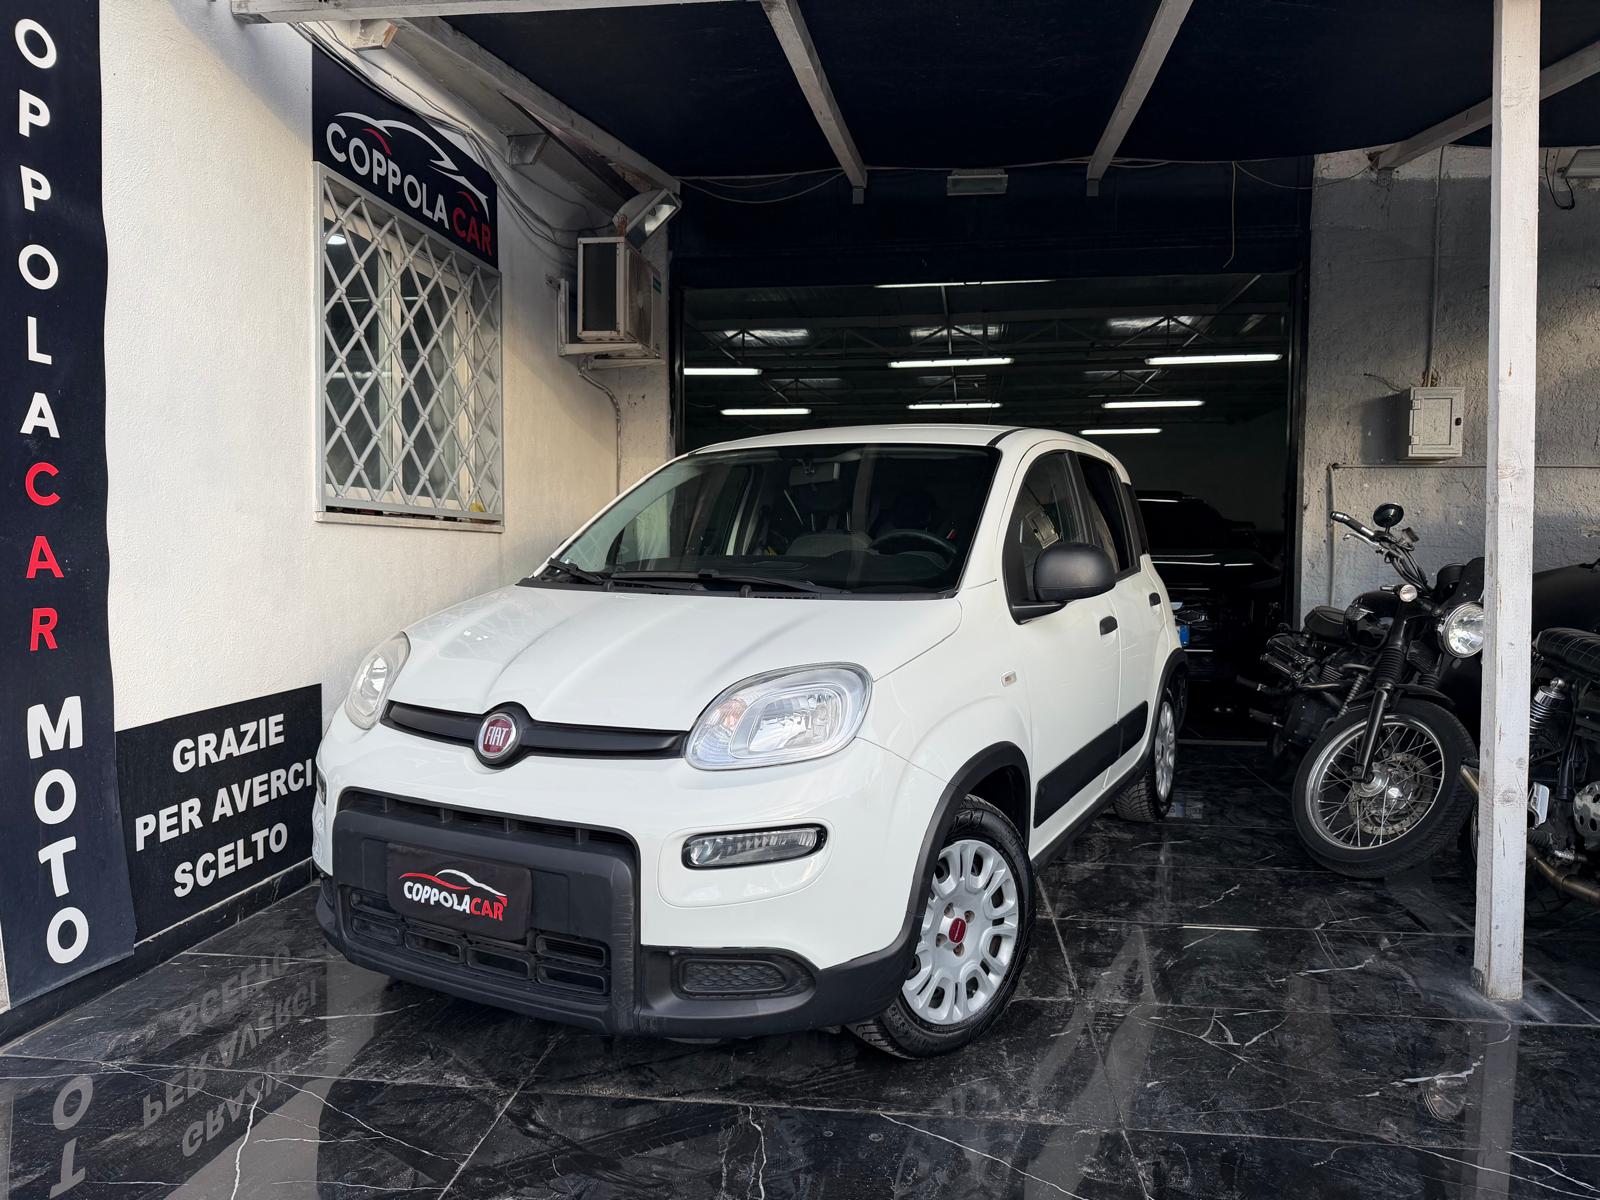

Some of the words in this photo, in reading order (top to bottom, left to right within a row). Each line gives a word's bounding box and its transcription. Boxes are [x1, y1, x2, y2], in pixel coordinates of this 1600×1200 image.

[172, 713, 285, 774] GRAZIE
[484, 726, 509, 747] FIAT
[27, 696, 90, 964] MOTO
[135, 797, 203, 852] PER
[211, 758, 313, 824] AVERCI
[173, 822, 288, 898] SCELTO
